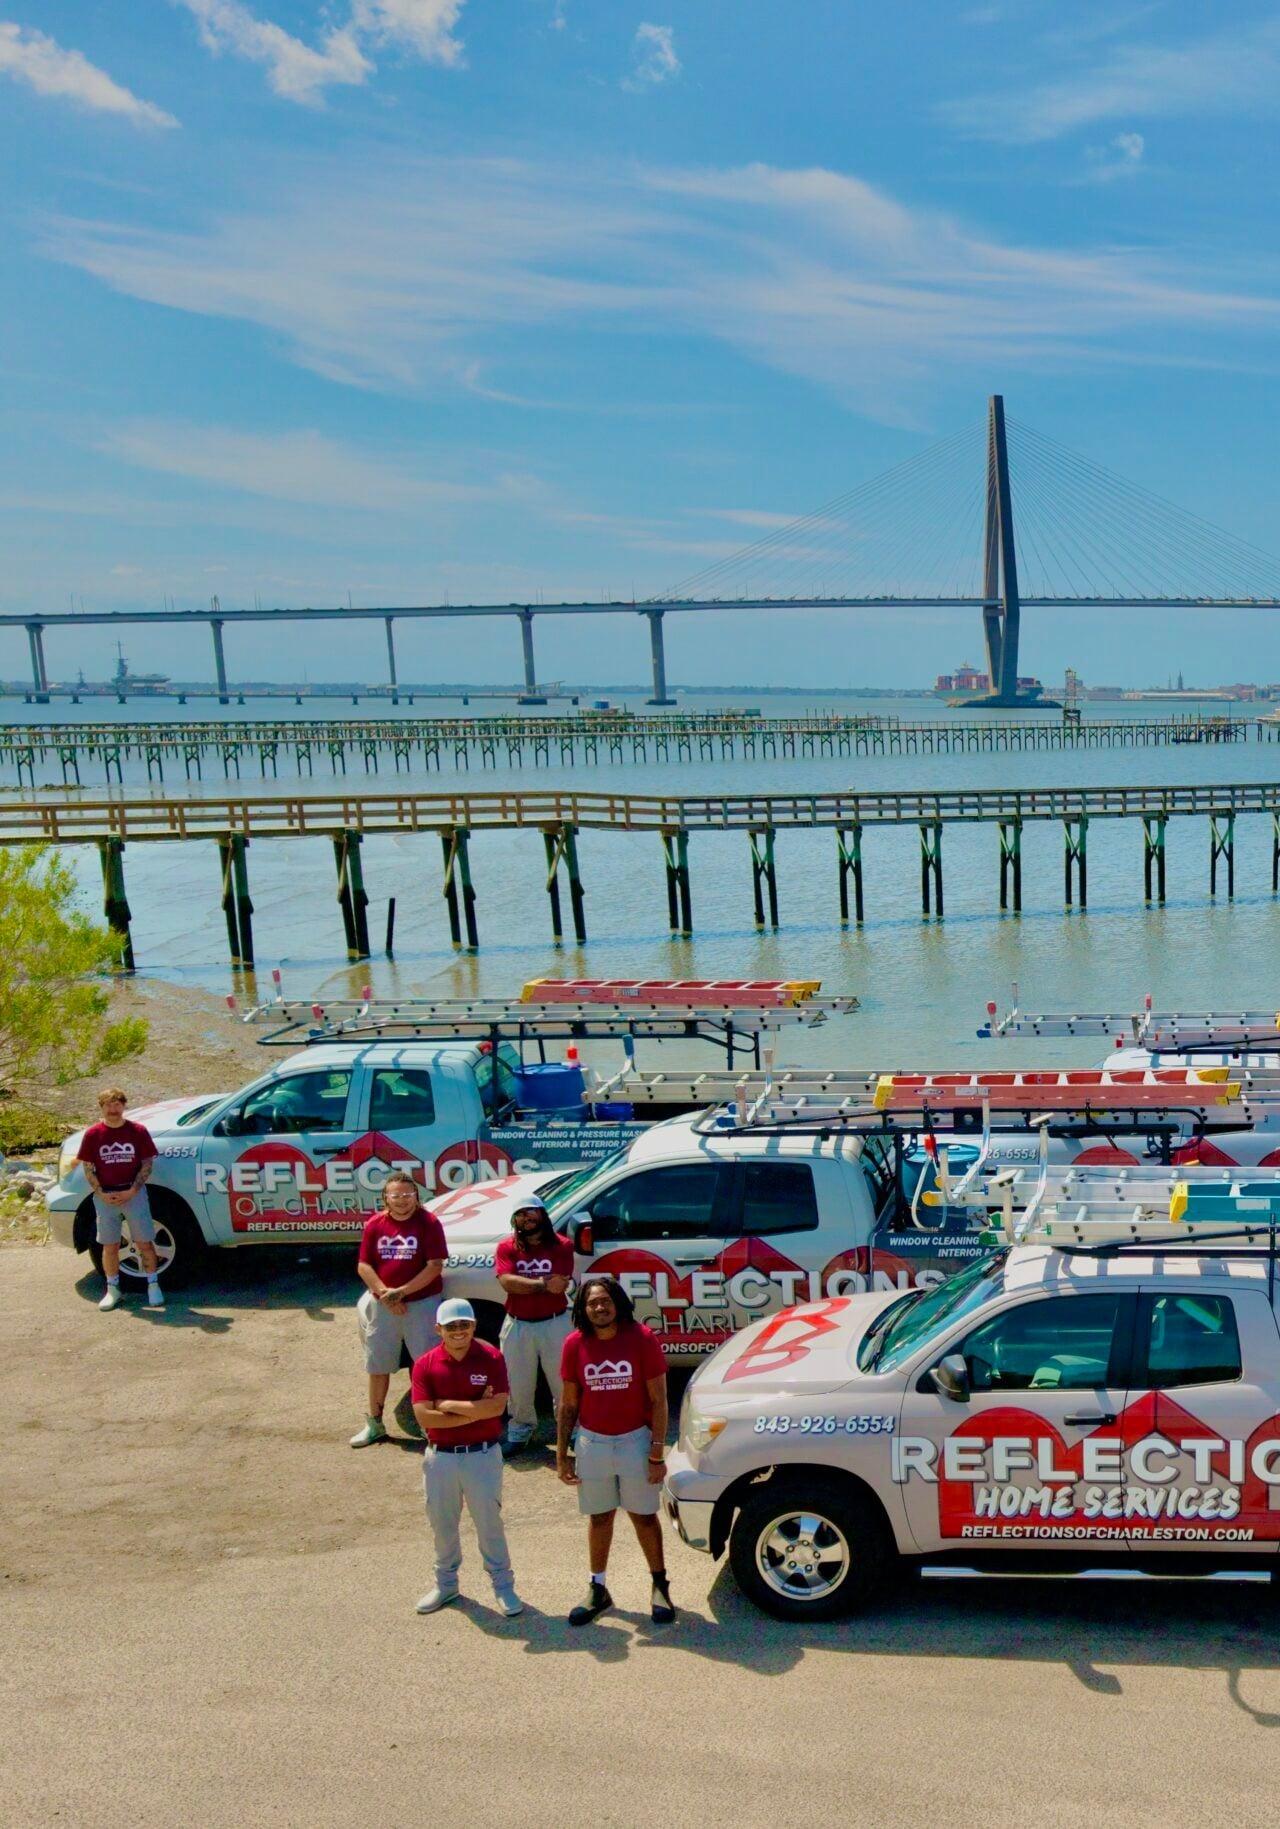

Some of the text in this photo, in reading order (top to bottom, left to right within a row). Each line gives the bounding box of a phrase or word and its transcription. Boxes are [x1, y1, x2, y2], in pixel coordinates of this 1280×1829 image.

[491, 1131, 525, 1139] WINDOW
[527, 1131, 568, 1139] CLEANING
[532, 1140, 571, 1148] INTERIOR
[572, 1140, 578, 1148] &
[579, 1140, 619, 1148] EXTERIOR
[986, 1149, 1038, 1160] 26-6554
[236, 1194, 384, 1216] OF CHARLE
[247, 1221, 368, 1232] REFLECTIONSOFCHA
[889, 1236, 980, 1246] WINDOW CLEANING
[938, 1248, 983, 1257] INTERIOR
[641, 1313, 764, 1335] CHARLE
[585, 1376, 633, 1386] REFLECTIONS
[753, 1415, 896, 1434] 843-926-6554
[975, 1485, 1241, 1521] HOME SERVICES
[961, 1525, 1254, 1541] REFLECTIONSOFCHARLESTON.COM
